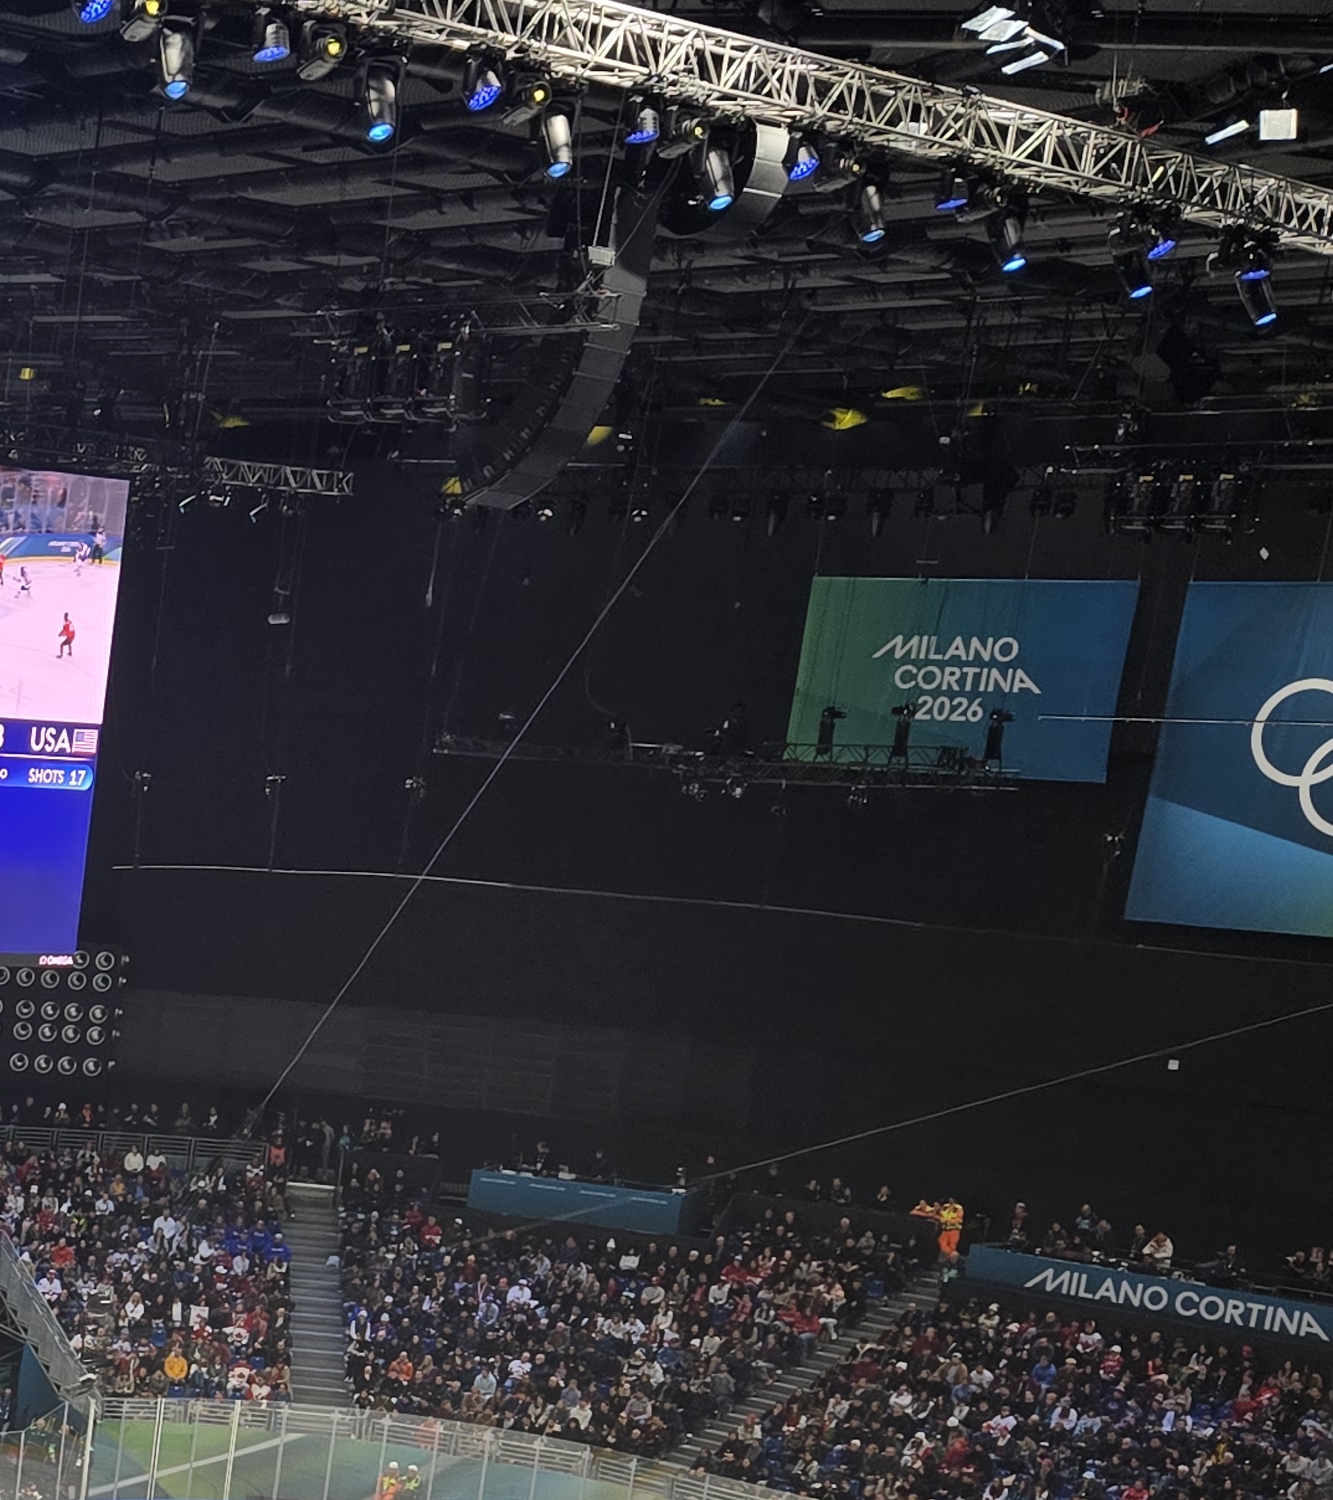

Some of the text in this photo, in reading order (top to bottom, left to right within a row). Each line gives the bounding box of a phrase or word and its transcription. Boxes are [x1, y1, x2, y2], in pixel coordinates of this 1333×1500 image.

[872, 635, 1019, 662] MILANO
[894, 664, 1042, 694] CORTINA
[914, 695, 984, 722] 2026
[30, 727, 71, 753] USA
[28, 767, 86, 786] SHOTS 17
[1024, 1268, 1331, 1342] MILANO CORTINA
